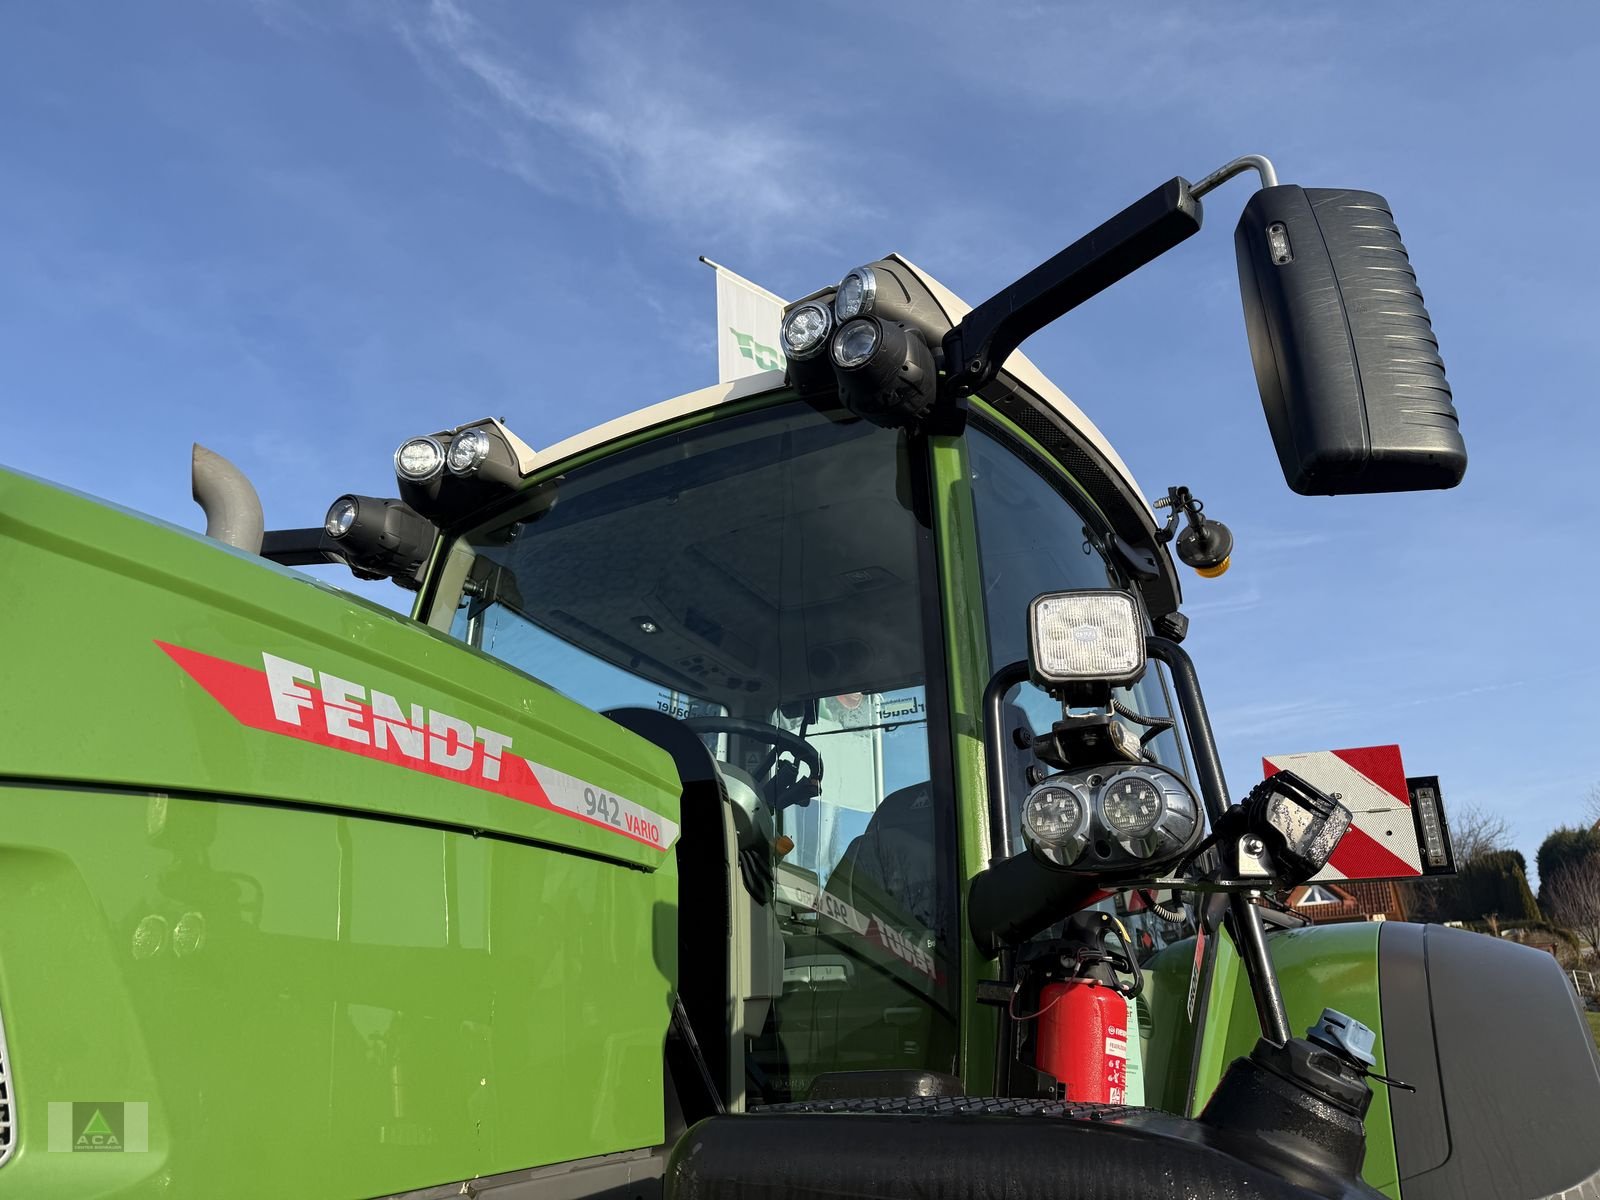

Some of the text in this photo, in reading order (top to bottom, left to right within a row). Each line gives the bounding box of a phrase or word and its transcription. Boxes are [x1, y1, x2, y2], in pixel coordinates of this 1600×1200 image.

[262, 651, 513, 782] FENDT
[584, 787, 659, 843] 942 VARIO
